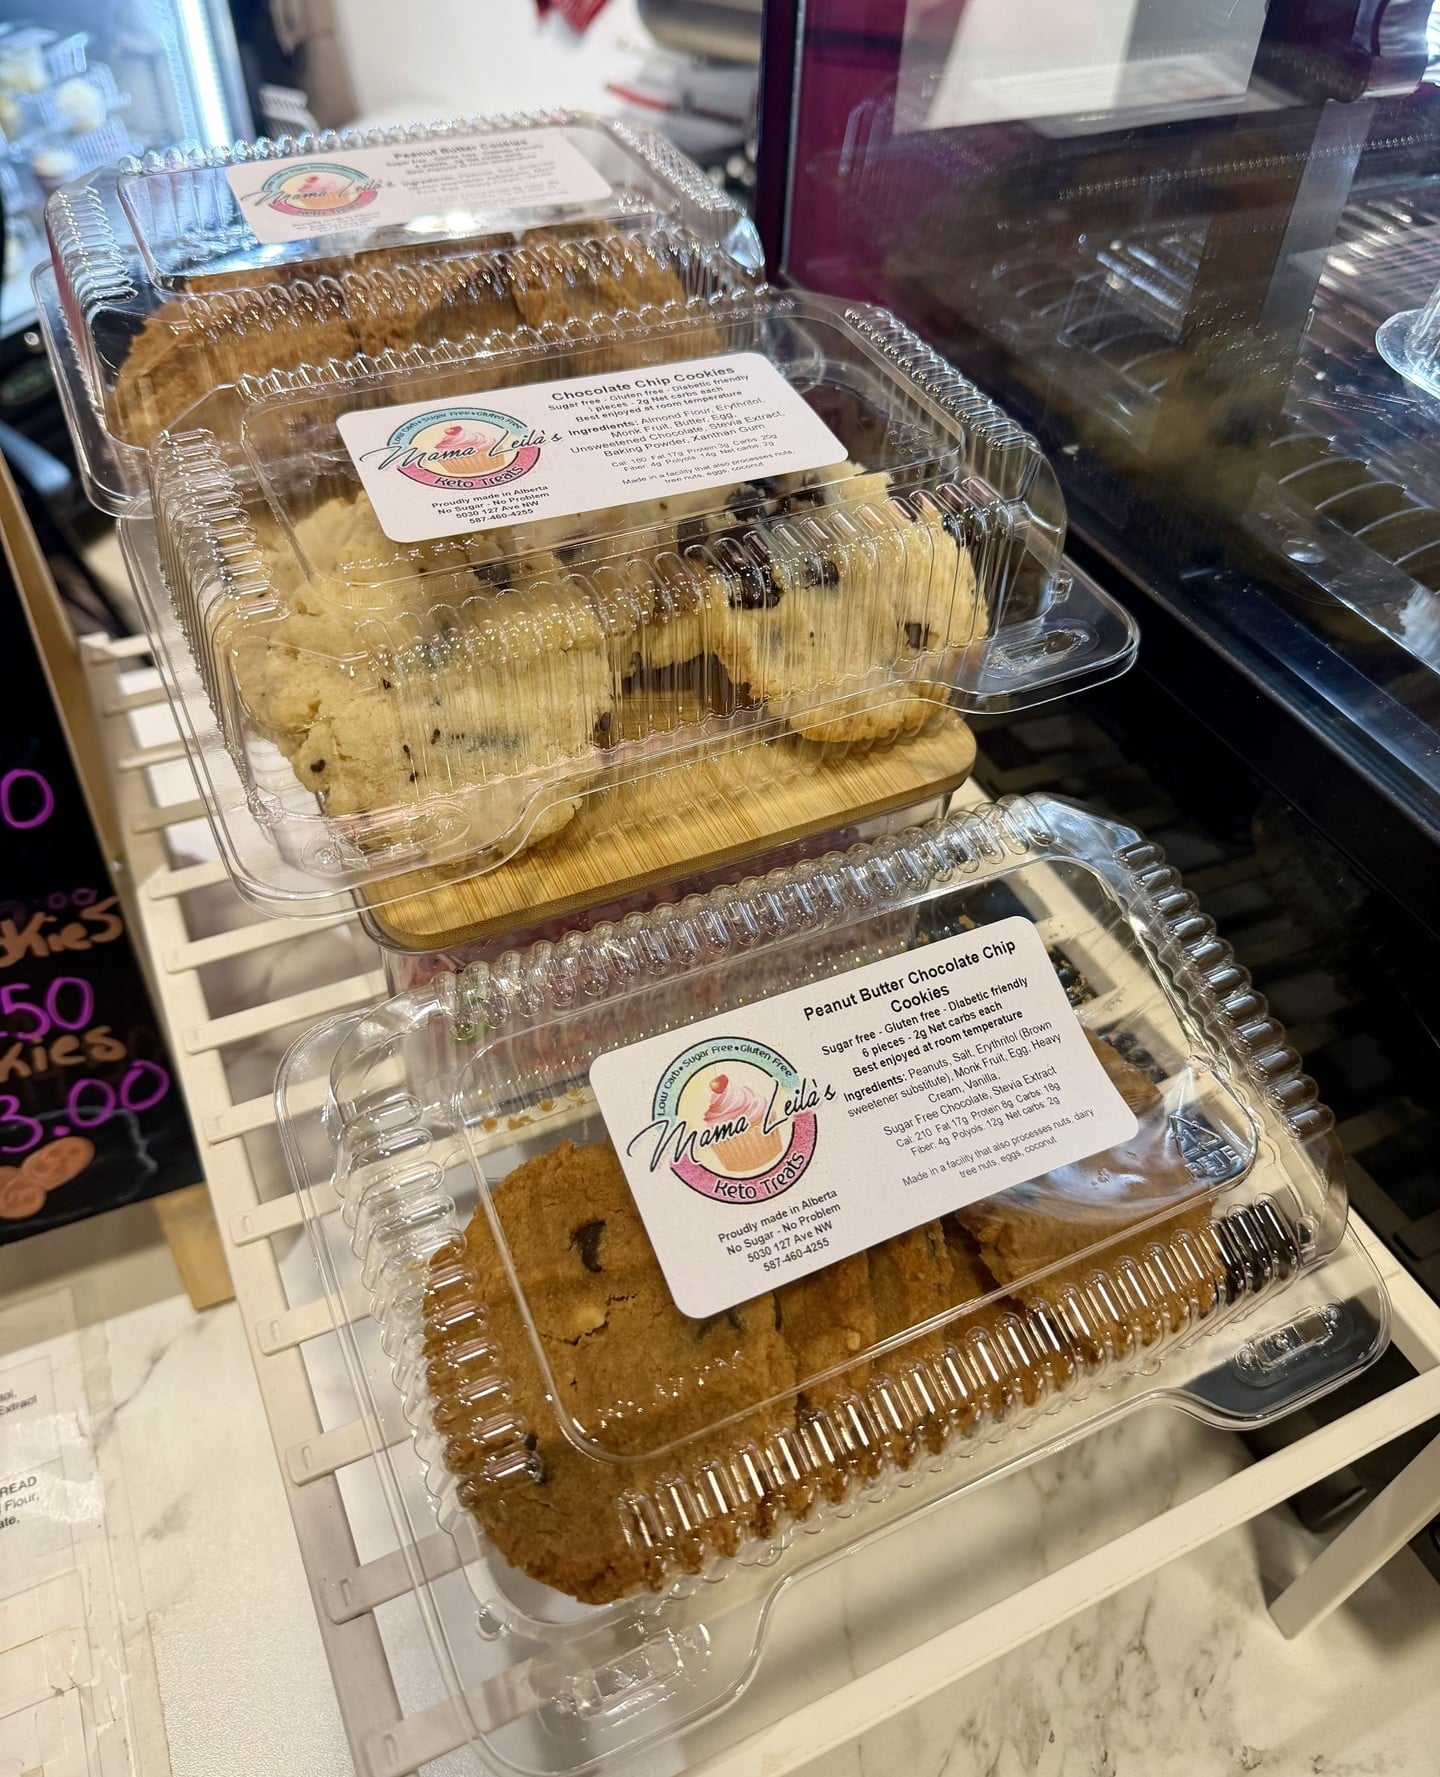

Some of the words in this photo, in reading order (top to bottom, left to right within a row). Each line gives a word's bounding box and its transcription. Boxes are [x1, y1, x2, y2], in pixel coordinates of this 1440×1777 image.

[547, 401, 579, 411] Sugar
[580, 398, 601, 406] free
[608, 391, 644, 402] Gluten
[643, 388, 664, 397] free
[712, 374, 749, 385] friendly
[551, 383, 631, 401] Chocolate
[633, 377, 671, 388] Chip
[673, 367, 735, 382] Cookies
[594, 401, 629, 413] pieces
[650, 394, 670, 403] Net
[699, 386, 724, 395] each
[567, 419, 640, 437] Ingredients:
[640, 411, 682, 425] Almond
[574, 413, 601, 423] Best
[601, 406, 642, 419] enjoyed
[655, 400, 683, 410] room
[682, 390, 742, 405] temperature
[609, 427, 643, 439] Monk
[642, 422, 673, 433] Fruit,
[673, 417, 710, 428] Butter,
[709, 412, 737, 421] Egg,
[569, 434, 648, 454] Unsweetened
[707, 419, 743, 430] Stevia
[602, 445, 644, 458] Baking
[643, 437, 691, 450] Powder,
[690, 428, 737, 442] Xanthan
[737, 423, 766, 433] Gum
[359, 445, 476, 471] Mama
[435, 476, 474, 489] Keto
[477, 465, 524, 487] Treats
[430, 497, 470, 509] Proudly
[472, 493, 500, 502] made
[513, 485, 549, 496] Alberta
[453, 502, 484, 512] Sugar
[491, 498, 507, 506] No
[507, 492, 550, 503] Problem
[455, 509, 480, 519] 5030
[481, 506, 499, 515] 127
[501, 504, 520, 512] Ave
[520, 499, 539, 508] NW
[468, 507, 534, 524] 587-460-4255
[802, 992, 859, 1021] Peanut
[858, 977, 905, 1002] Butter
[907, 952, 980, 985] Chocolate
[981, 940, 1016, 959] Chip
[889, 984, 950, 1013] Cookies
[820, 1038, 854, 1056] Sugar
[854, 1030, 877, 1045] free
[883, 1015, 920, 1034] Gluten
[919, 1007, 941, 1022] free
[947, 990, 990, 1012] Diabetic
[989, 976, 1028, 997] friendly
[861, 1047, 870, 1058] 6
[870, 1036, 906, 1058] pieces
[912, 1028, 928, 1040] 2g
[926, 1020, 948, 1035] Net
[947, 1010, 977, 1028] carbs
[977, 1000, 1003, 1017] each
[842, 1072, 908, 1103] Ingredients:
[907, 1058, 953, 1079] Peanuts,
[951, 1048, 976, 1063] Salt,
[974, 1031, 1019, 1055] Erythritol
[1018, 1021, 1053, 1041] (Brown
[851, 1060, 879, 1078] Best
[878, 1044, 921, 1068] enjoyed
[921, 1040, 934, 1053] at
[933, 1032, 962, 1049] room
[961, 1010, 1024, 1038] temperature
[656, 1094, 668, 1116] Low
[663, 1068, 681, 1090] Carb
[682, 1048, 710, 1068] Sugar
[711, 1044, 734, 1055] Free
[739, 1044, 771, 1061] Gluten
[772, 1056, 793, 1078] Free
[846, 1091, 899, 1118] sweetener
[899, 1071, 955, 1098] substitute),
[952, 1060, 983, 1079] Monk
[980, 1052, 1009, 1068] Fruit,
[1006, 1045, 1032, 1059] Egg,
[1029, 1033, 1062, 1050] Heavy
[927, 1085, 966, 1104] Cream,
[962, 1072, 1001, 1090] Vanilla,
[882, 1118, 914, 1136] Sugar
[913, 1110, 940, 1125] Free
[939, 1091, 993, 1115] Chocolate,
[990, 1079, 1024, 1096] Stevia
[1021, 1065, 1058, 1085] Extract
[895, 1134, 915, 1148] Cal:
[913, 1127, 933, 1141] 210
[933, 1121, 952, 1134] Fat
[950, 1115, 970, 1127] 17g
[969, 1103, 1002, 1121] Protein
[999, 1099, 1015, 1109] 8g
[1014, 1088, 1042, 1104] Carbs:
[1042, 1081, 1061, 1093] 18g
[626, 1116, 749, 1173] Mama
[909, 1141, 937, 1157] Fiber:
[937, 1136, 951, 1147] 4g
[950, 1123, 986, 1141] Polyols:
[985, 1116, 1005, 1128] 12g
[1003, 1108, 1023, 1121] Net
[1021, 1101, 1046, 1115] carbs:
[1045, 1095, 1061, 1106] 2g
[901, 1171, 929, 1187] Made
[927, 1166, 940, 1176] in
[938, 1163, 947, 1173] a
[945, 1153, 975, 1169] facility
[973, 1145, 993, 1159] that
[991, 1139, 1012, 1152] also
[1009, 1123, 1053, 1147] processes
[1051, 1116, 1074, 1129] nuts,
[1073, 1108, 1095, 1121] dairy
[958, 1166, 978, 1179] tree
[976, 1158, 1001, 1172] nuts,
[999, 1149, 1025, 1163] eggs,
[1023, 1134, 1058, 1154] coconut
[714, 1179, 757, 1199] Keto
[760, 1152, 805, 1194] Treats
[717, 1221, 758, 1243] Proudly
[759, 1209, 789, 1227] made
[787, 1205, 801, 1215] in
[801, 1189, 838, 1211] Alberta
[725, 1244, 743, 1256] No
[742, 1230, 774, 1249] Sugar
[780, 1221, 798, 1233] No
[797, 1203, 842, 1227] Problem
[746, 1245, 772, 1263] 5030
[773, 1236, 791, 1252] 127
[793, 1230, 814, 1245] Ave
[813, 1219, 833, 1235] NW
[762, 1236, 830, 1272] 587-460-4255
